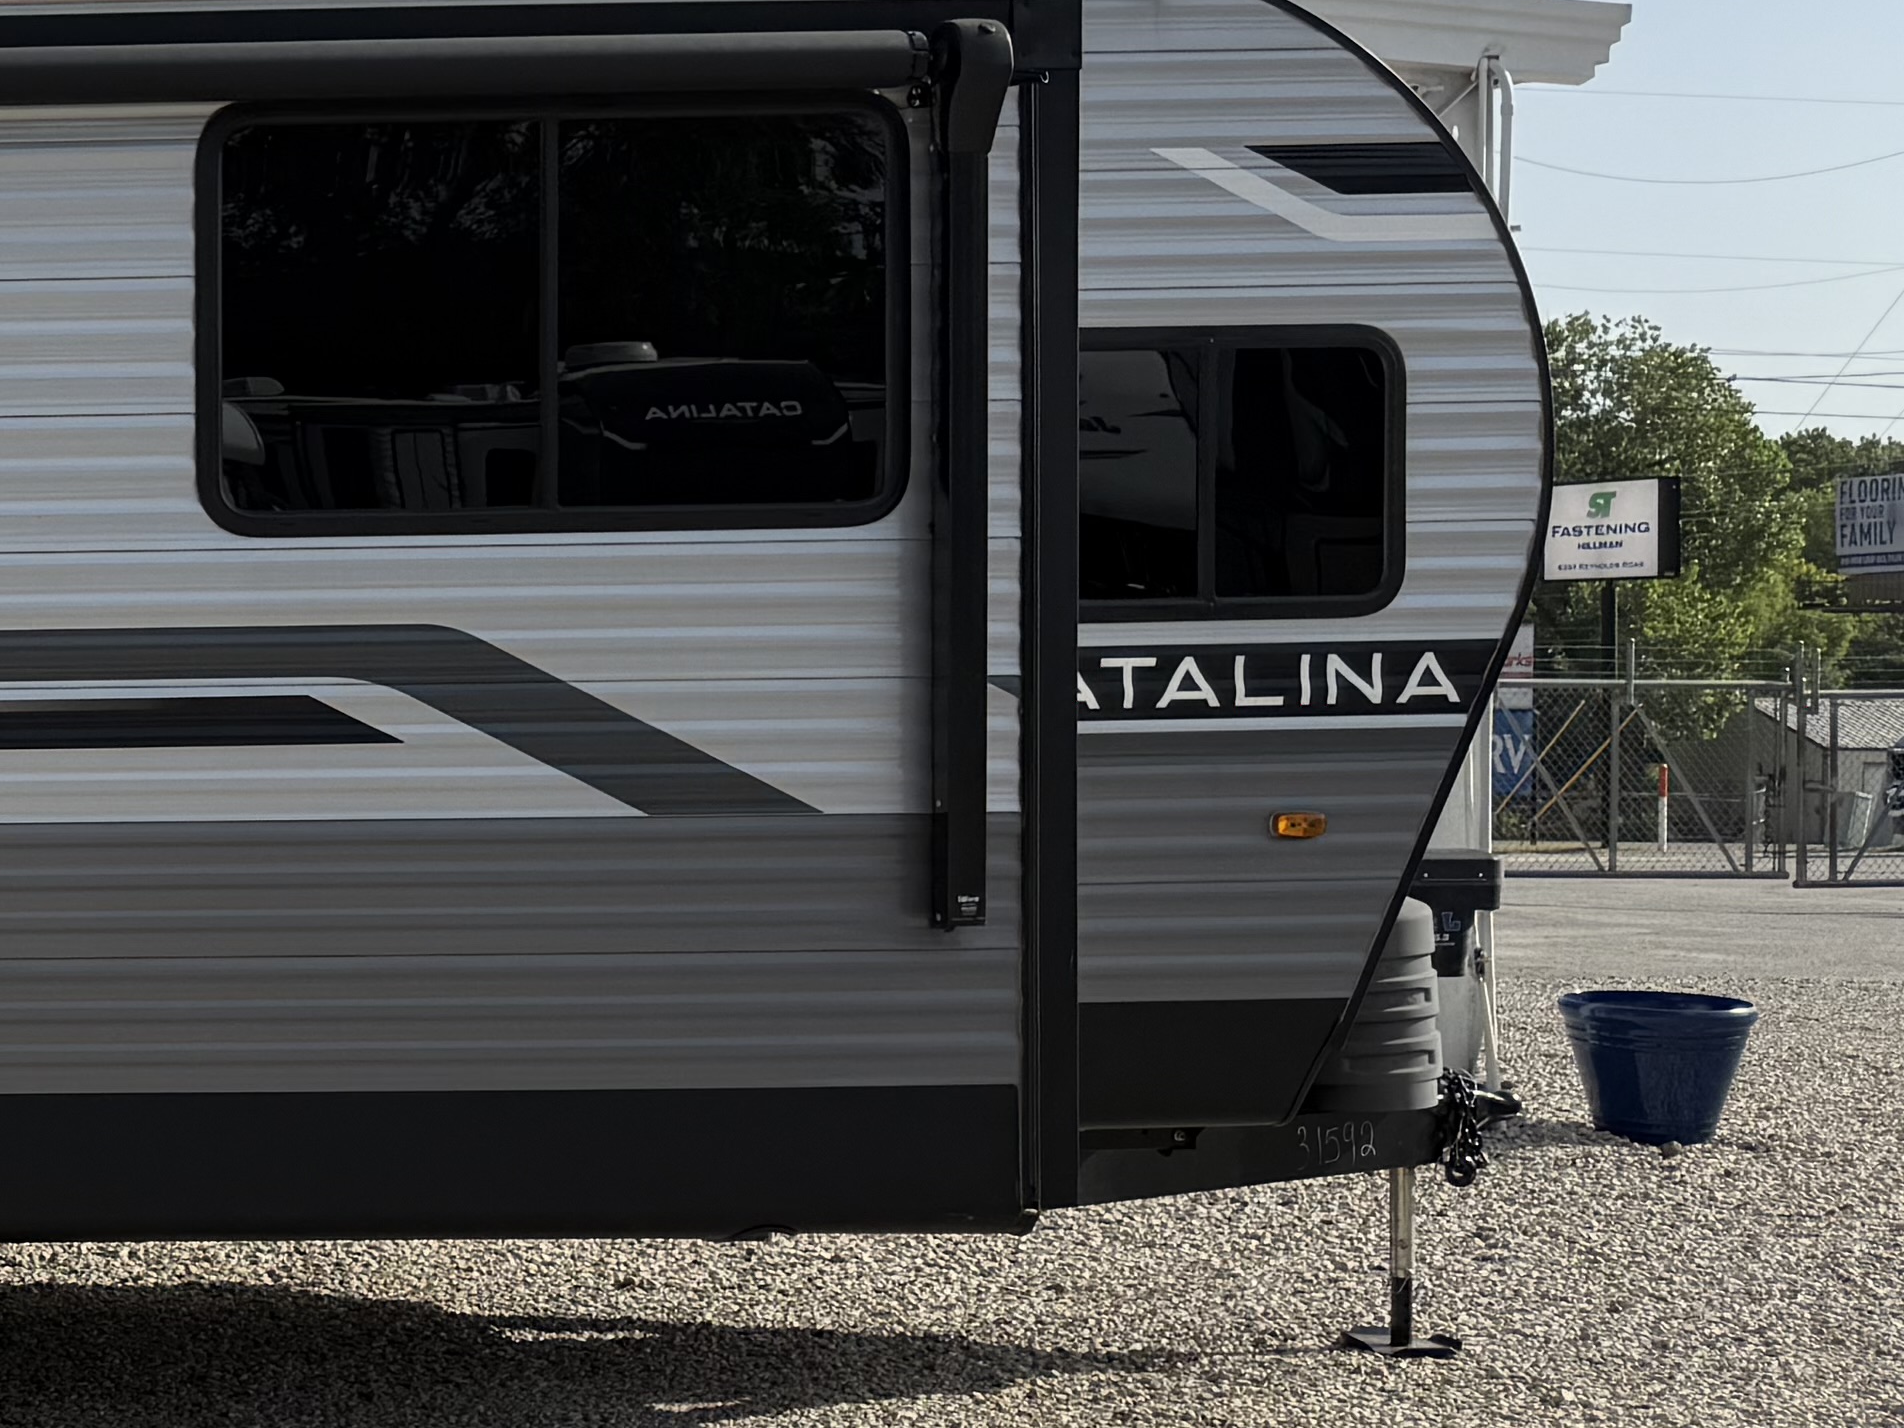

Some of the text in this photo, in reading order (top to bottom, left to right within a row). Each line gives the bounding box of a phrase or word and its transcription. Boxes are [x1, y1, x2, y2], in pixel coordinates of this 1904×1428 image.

[1552, 521, 1651, 538] FASTENING
[1840, 521, 1896, 548] FAMILY
[1296, 1120, 1377, 1171] 31592
